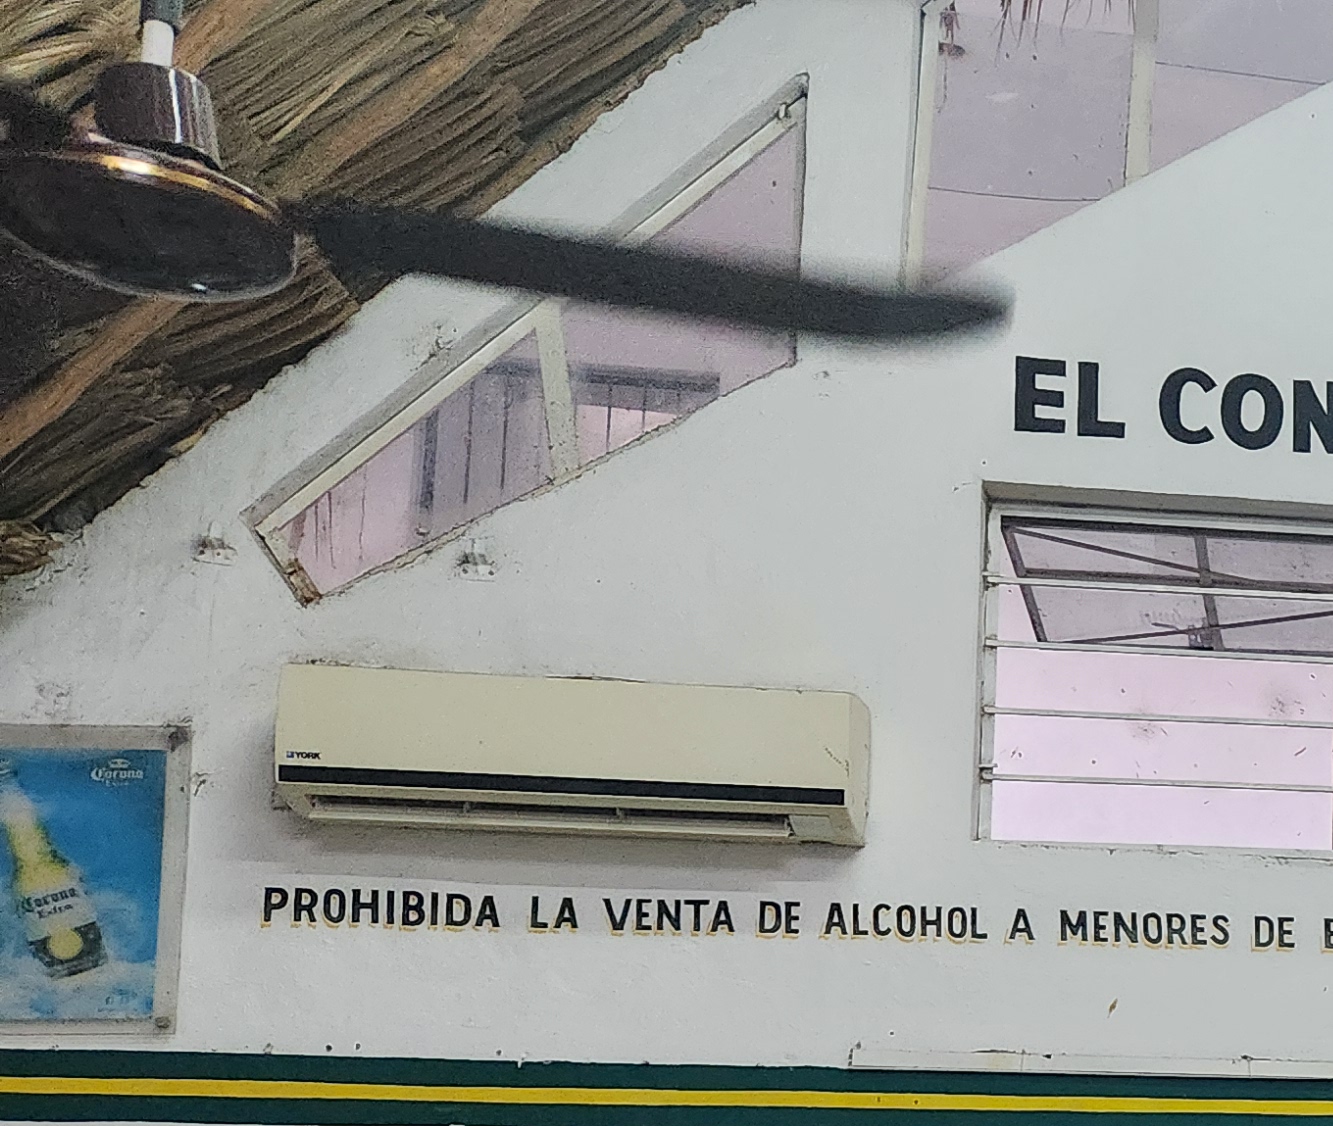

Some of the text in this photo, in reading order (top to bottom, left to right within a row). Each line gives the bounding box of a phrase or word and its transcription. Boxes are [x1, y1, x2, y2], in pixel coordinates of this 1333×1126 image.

[1013, 356, 1125, 439] EL
[294, 751, 321, 760] YORK
[90, 768, 144, 781] Corona
[21, 887, 77, 912] Corona
[262, 887, 501, 930] PROHIBIDA
[529, 896, 579, 933] LA
[603, 898, 735, 936] VENTA
[758, 900, 800, 938] DE
[824, 902, 988, 942] ALCOHOL
[1007, 908, 1036, 943] A
[1058, 909, 1230, 949] MENORES
[1252, 915, 1295, 951] DE
